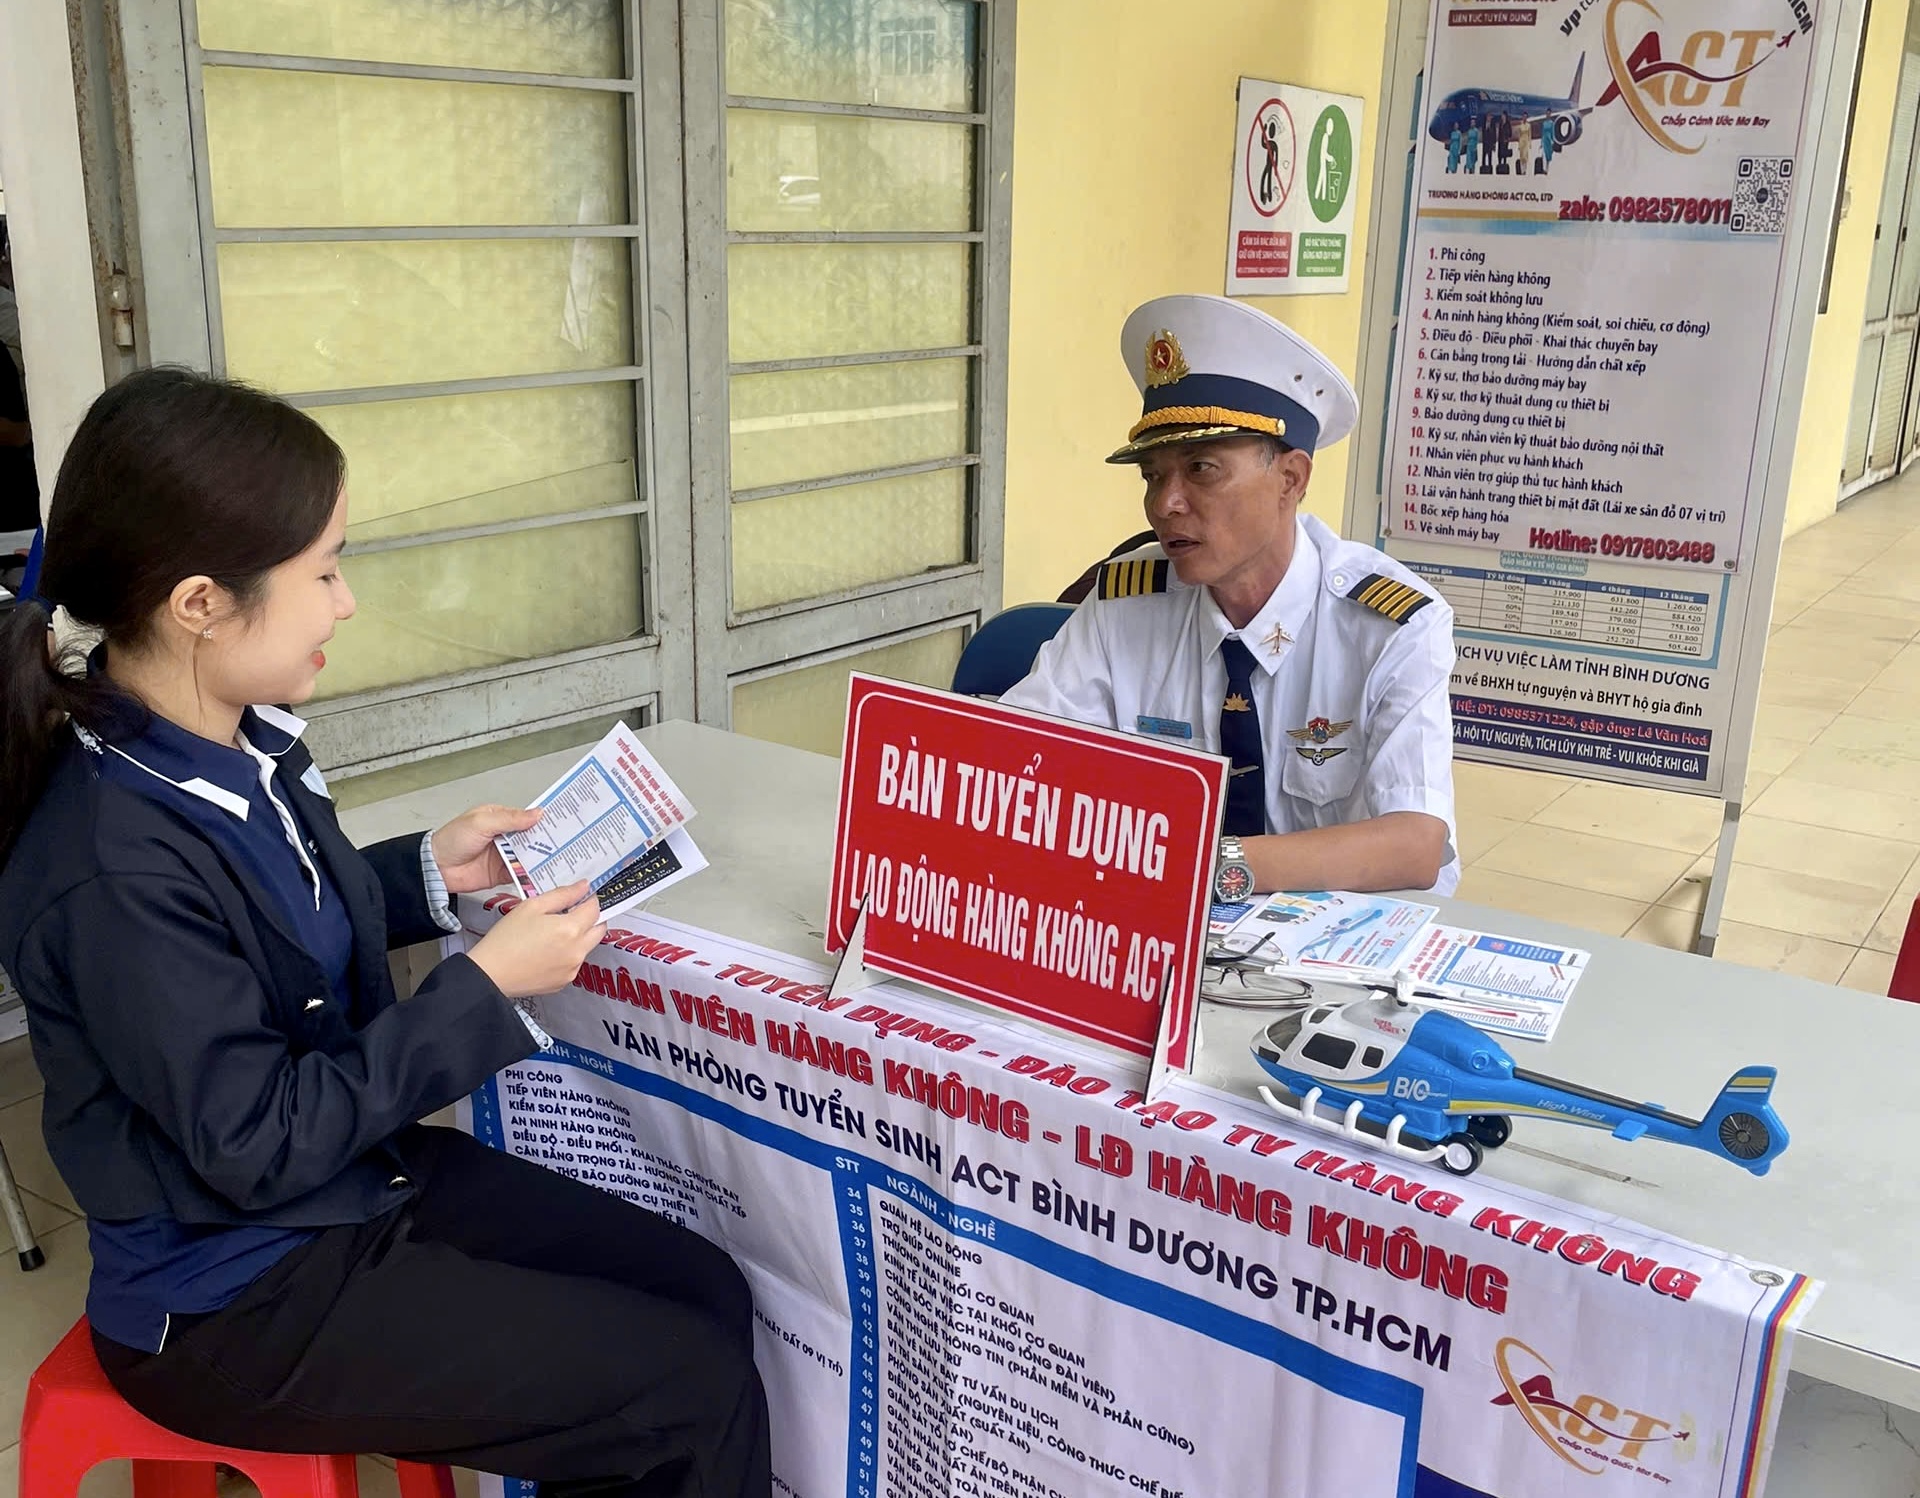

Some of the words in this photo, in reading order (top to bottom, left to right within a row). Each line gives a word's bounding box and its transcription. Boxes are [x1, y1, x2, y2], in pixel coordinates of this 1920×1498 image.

[1595, 30, 1776, 107] ACT
[1558, 195, 1606, 221] zalo:
[1608, 196, 1732, 224] 0982578011
[1429, 247, 1439, 259] 1.
[1440, 246, 1458, 260] Phi
[1459, 248, 1485, 265] công
[1426, 267, 1436, 280] 2.
[1424, 287, 1434, 300] 3.
[1407, 464, 1421, 476] 12.
[1404, 519, 1417, 530] 15.
[1529, 528, 1598, 555] Hotline:
[1600, 533, 1716, 564] 0917803488
[1484, 648, 1503, 665] VỤ
[1506, 650, 1538, 669] VIỆC
[1540, 654, 1571, 671] LÀM
[1574, 657, 1609, 676] TỈNH
[1612, 663, 1649, 682] BÌNH
[1652, 670, 1709, 689] DƯƠNG
[1464, 672, 1478, 685] về
[1480, 674, 1514, 690] BHXH
[1517, 680, 1531, 696] tự
[1532, 684, 1577, 701] nguyện
[1580, 688, 1593, 701] và
[1596, 690, 1631, 706] BHYT
[1632, 694, 1649, 709] hộ
[1651, 698, 1670, 714] gia
[1673, 701, 1702, 716] đình
[1462, 725, 1479, 742] HỘI
[1481, 726, 1494, 742] TỰ
[1494, 732, 1535, 750] NGUYỆN,
[1535, 735, 1556, 751] TÍCH
[1558, 738, 1577, 756] LŨY
[1576, 743, 1593, 757] KHI
[1594, 743, 1612, 760] TRẺ
[1618, 749, 1634, 763] VUI
[1635, 750, 1662, 768] KHỎE
[1663, 756, 1681, 770] KHI
[1682, 757, 1699, 773] GIÀ
[877, 735, 947, 820] BÀN
[956, 752, 1062, 851] TUYỂN
[1067, 791, 1170, 882] DỤNG
[850, 849, 892, 918] LAO
[895, 854, 960, 943] ĐỘNG
[962, 873, 1030, 962] HÀNG
[1032, 900, 1119, 990] KHÔNG
[1122, 932, 1176, 1006] ACT
[505, 1069, 524, 1080] PHI
[526, 1070, 563, 1084] CÔNG
[579, 1054, 614, 1076] NGHỀ
[506, 1083, 528, 1096] TIẾP
[533, 1086, 557, 1099] VIÊN
[560, 1088, 593, 1104] HÀNG
[596, 1096, 630, 1116] KHÔNG
[509, 1099, 535, 1113] KIỂM
[538, 1102, 567, 1116] SOÁT
[570, 1106, 612, 1122] KHÔNG
[600, 929, 697, 965] SINH
[715, 963, 852, 1012] TUYỂN
[844, 1004, 977, 1052] DỤNG
[1003, 1054, 1112, 1096] ĐÀO
[1114, 1089, 1218, 1132] TẠO
[1223, 1124, 1297, 1158] TV
[1295, 1149, 1465, 1218] HÀNG
[1470, 1206, 1702, 1301] KHÔNG
[1537, 1098, 1568, 1113] High
[1570, 1105, 1605, 1122] Wind
[511, 1116, 527, 1127] AN
[530, 1118, 558, 1130] NINH
[561, 1120, 595, 1134] HÀNG
[598, 1127, 636, 1143] KHÔNG
[572, 961, 667, 1016] NHÂN
[671, 989, 758, 1047] VIÊN
[764, 1019, 874, 1086] HÀNG
[883, 1058, 1031, 1144] KHÔNG
[1074, 1124, 1134, 1178] LĐ
[1148, 1149, 1294, 1236] HÀNG
[1307, 1204, 1510, 1315] KHÔNG
[602, 1018, 660, 1062] VĂN
[672, 1044, 768, 1101] PHÒNG
[774, 1081, 866, 1138] TUYỂN
[875, 1118, 942, 1174] SINH
[951, 1154, 1021, 1202] ACT
[1032, 1178, 1116, 1243] BÌNH
[1128, 1218, 1280, 1300] DƯƠNG
[1291, 1276, 1452, 1372] TP.HCM
[835, 1156, 860, 1174] STT
[886, 1175, 938, 1214] NGÀNH
[948, 1213, 996, 1241] NGHỀ
[847, 1188, 862, 1200] 34
[880, 1200, 908, 1224] QUAN
[910, 1218, 922, 1236] HỆ
[924, 1227, 943, 1248] LAO
[945, 1240, 982, 1265] ĐỘNG
[850, 1204, 864, 1216] 35
[880, 1216, 900, 1236] TRỢ
[902, 1230, 924, 1252] GIÚP
[926, 1248, 961, 1278] ONLINE
[852, 1220, 866, 1233] 36
[854, 1236, 866, 1249] 37
[856, 1252, 869, 1266] 38
[1490, 1374, 1670, 1461] ACT
